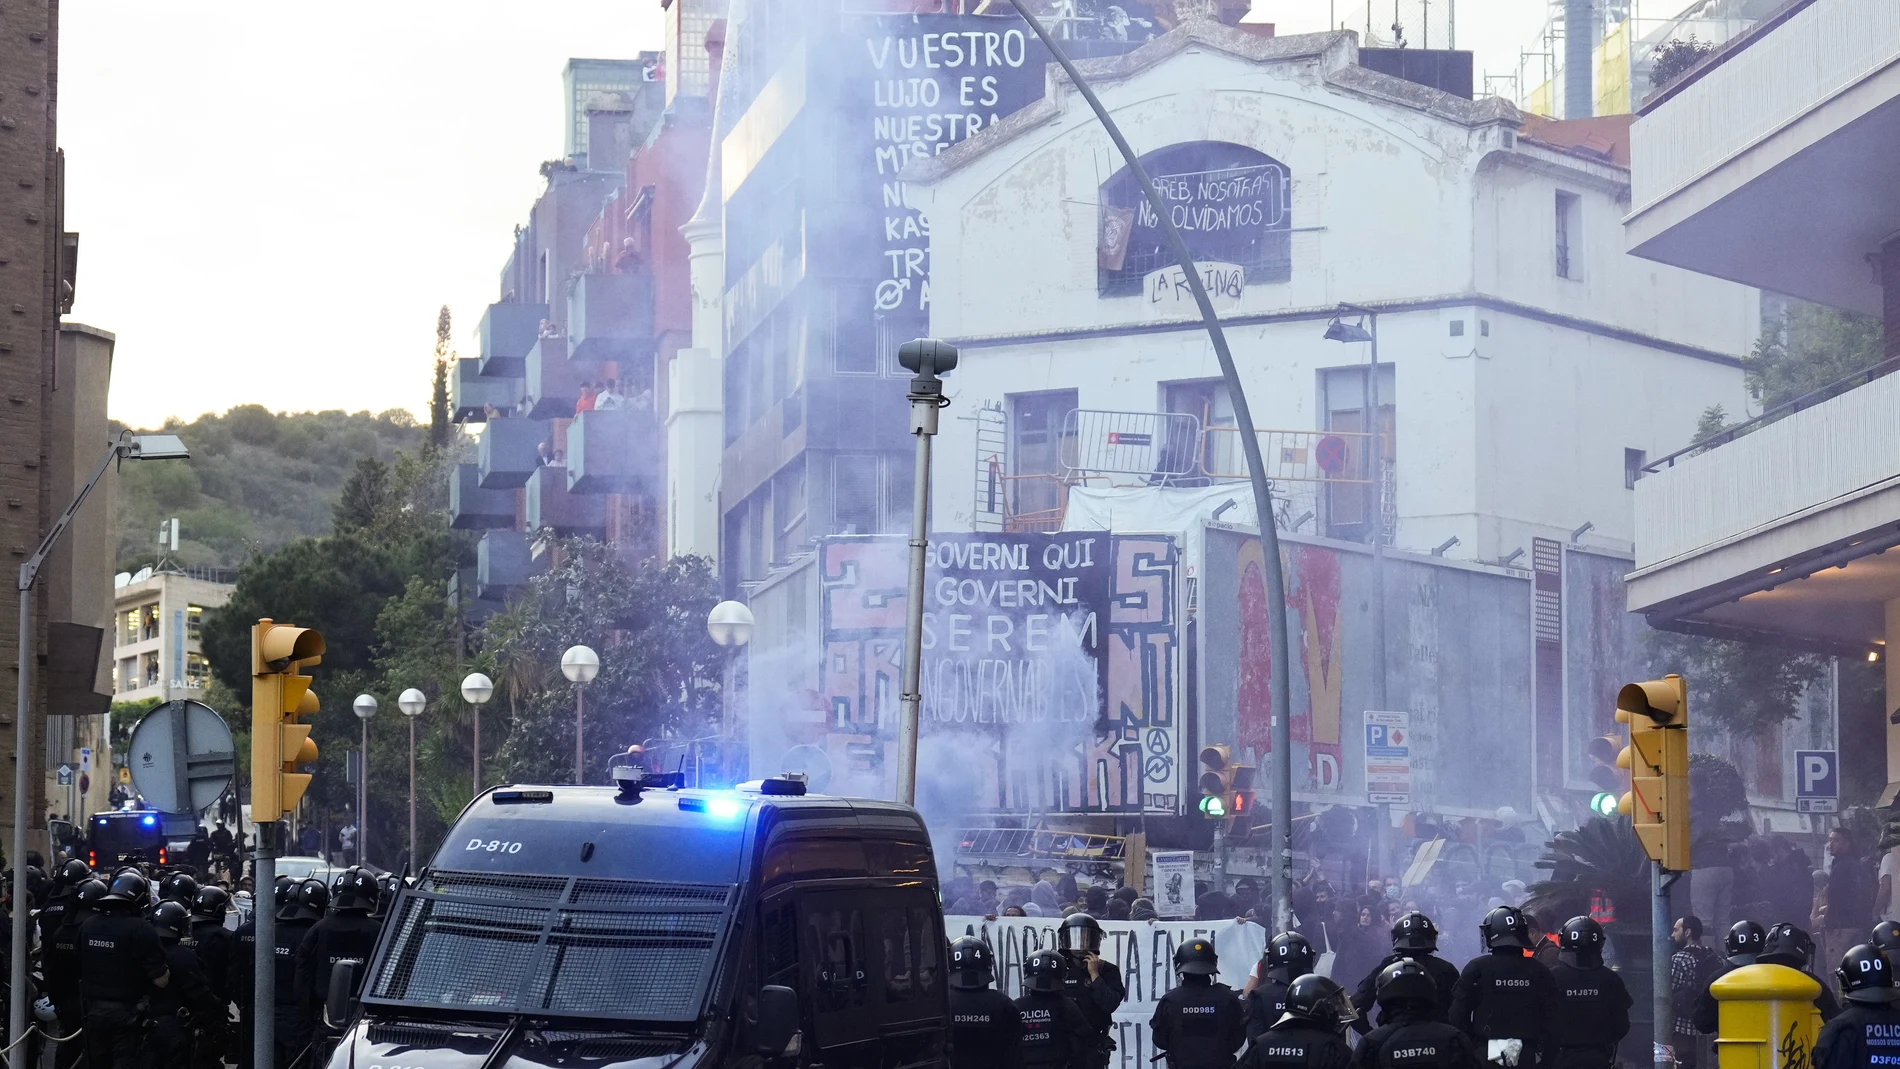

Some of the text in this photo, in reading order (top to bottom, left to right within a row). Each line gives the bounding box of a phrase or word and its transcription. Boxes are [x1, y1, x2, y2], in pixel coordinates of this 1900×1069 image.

[866, 29, 1025, 70] VUESTRO
[874, 76, 999, 108] LUJO ES
[1141, 177, 1194, 203] AREB,
[1042, 537, 1095, 570] QUI
[935, 577, 1079, 608] GOVERNI
[921, 612, 1098, 652] SEREM
[169, 679, 200, 689] SALLE
[1371, 726, 1382, 745] P
[1804, 755, 1829, 791] P
[465, 838, 523, 854] D-810
[62, 869, 70, 877] 4
[172, 878, 180, 886] 4
[355, 877, 364, 886] 4
[305, 886, 312, 895] 4
[388, 883, 396, 892] 4
[77, 891, 85, 900] 4
[155, 908, 163, 917] 4
[1404, 919, 1429, 929] D 3
[1505, 916, 1515, 926] D
[1571, 931, 1598, 942] D 3
[1783, 928, 1791, 937] 4
[1738, 933, 1760, 944] D 3
[954, 949, 982, 962] D 4
[1279, 946, 1308, 956] D 4
[1033, 958, 1058, 969] D 3
[1860, 958, 1882, 973] D 0
[1495, 979, 1530, 987] D1G505
[1295, 984, 1301, 996] 1
[1566, 988, 1599, 996] D1J879
[954, 1014, 990, 1023] D3H246
[1019, 1009, 1051, 1020] OLICIA
[1022, 1032, 1050, 1041] 2C363
[1393, 1046, 1436, 1058] D3B740
